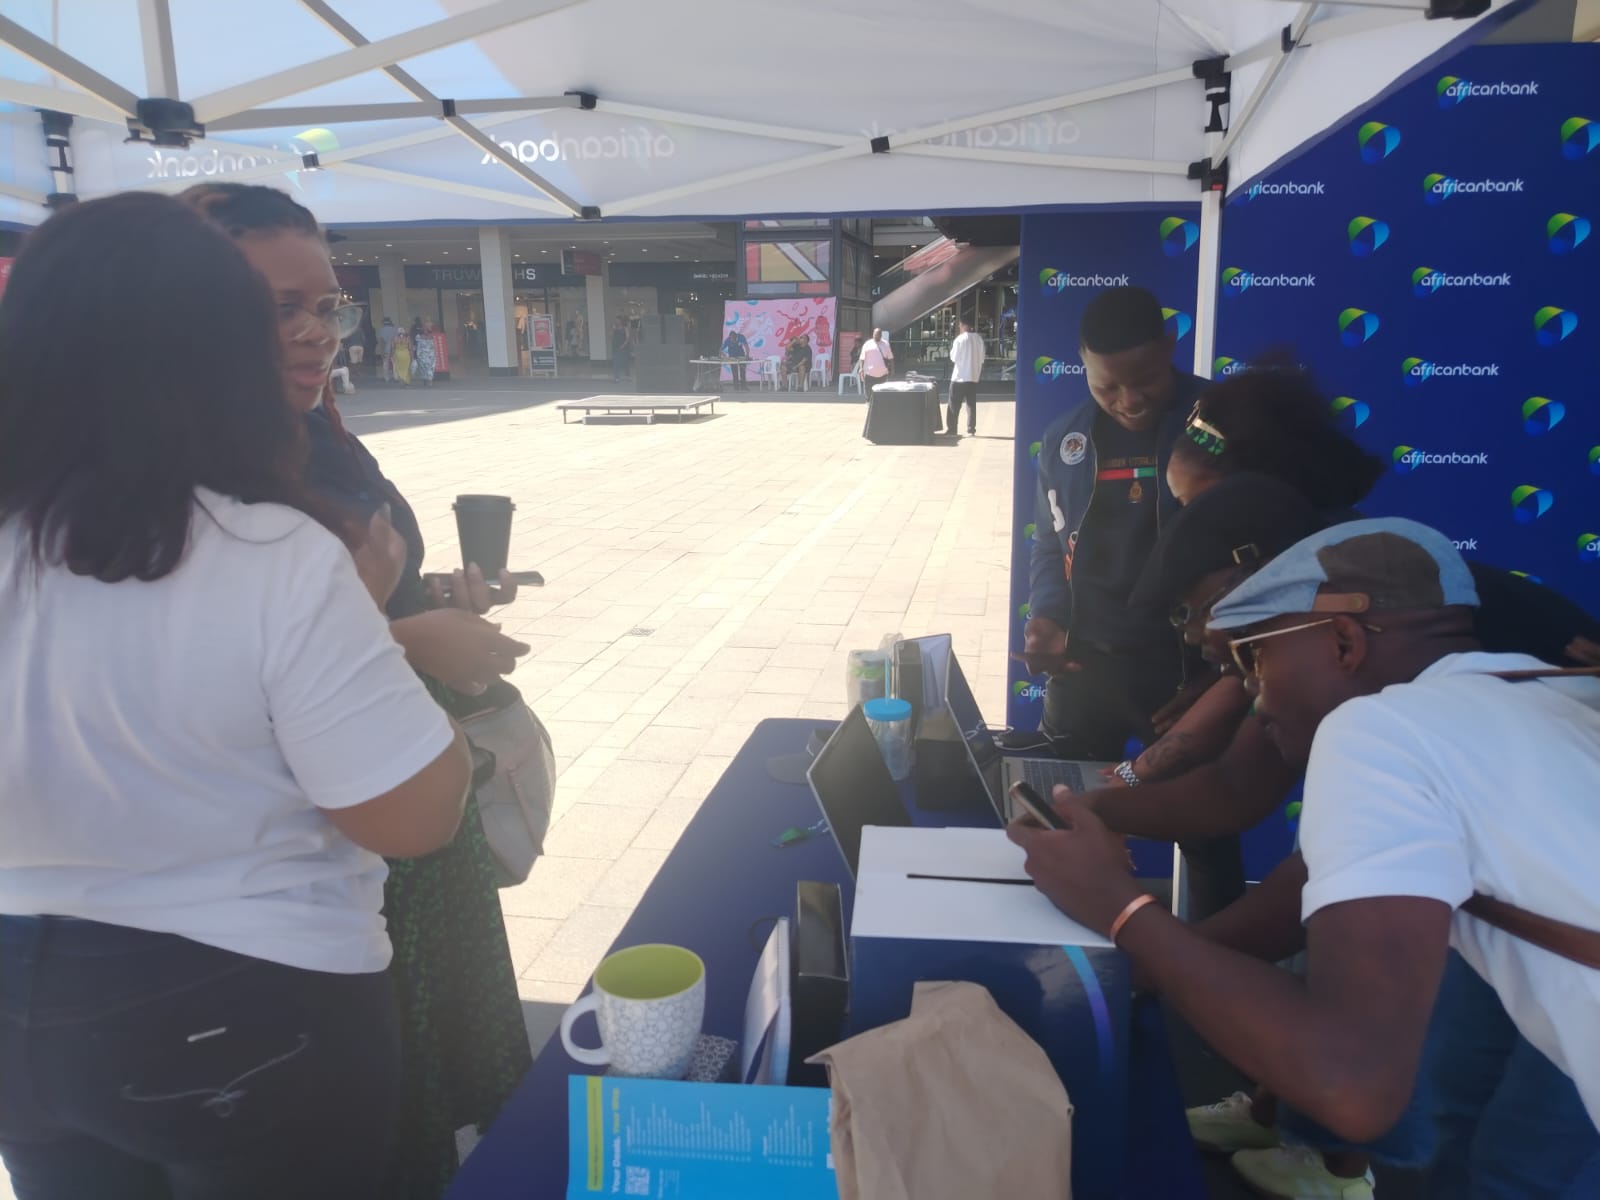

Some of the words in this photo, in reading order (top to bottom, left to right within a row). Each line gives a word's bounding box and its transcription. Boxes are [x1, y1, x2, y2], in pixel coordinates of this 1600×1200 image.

[1446, 79, 1538, 98] africanbank
[1432, 177, 1523, 194] africanbank
[1048, 271, 1129, 288] africanbank
[1230, 271, 1316, 288] africanbank
[1421, 270, 1511, 288] africanbank
[1410, 361, 1499, 377] africanbank
[1401, 449, 1488, 466] africanbank
